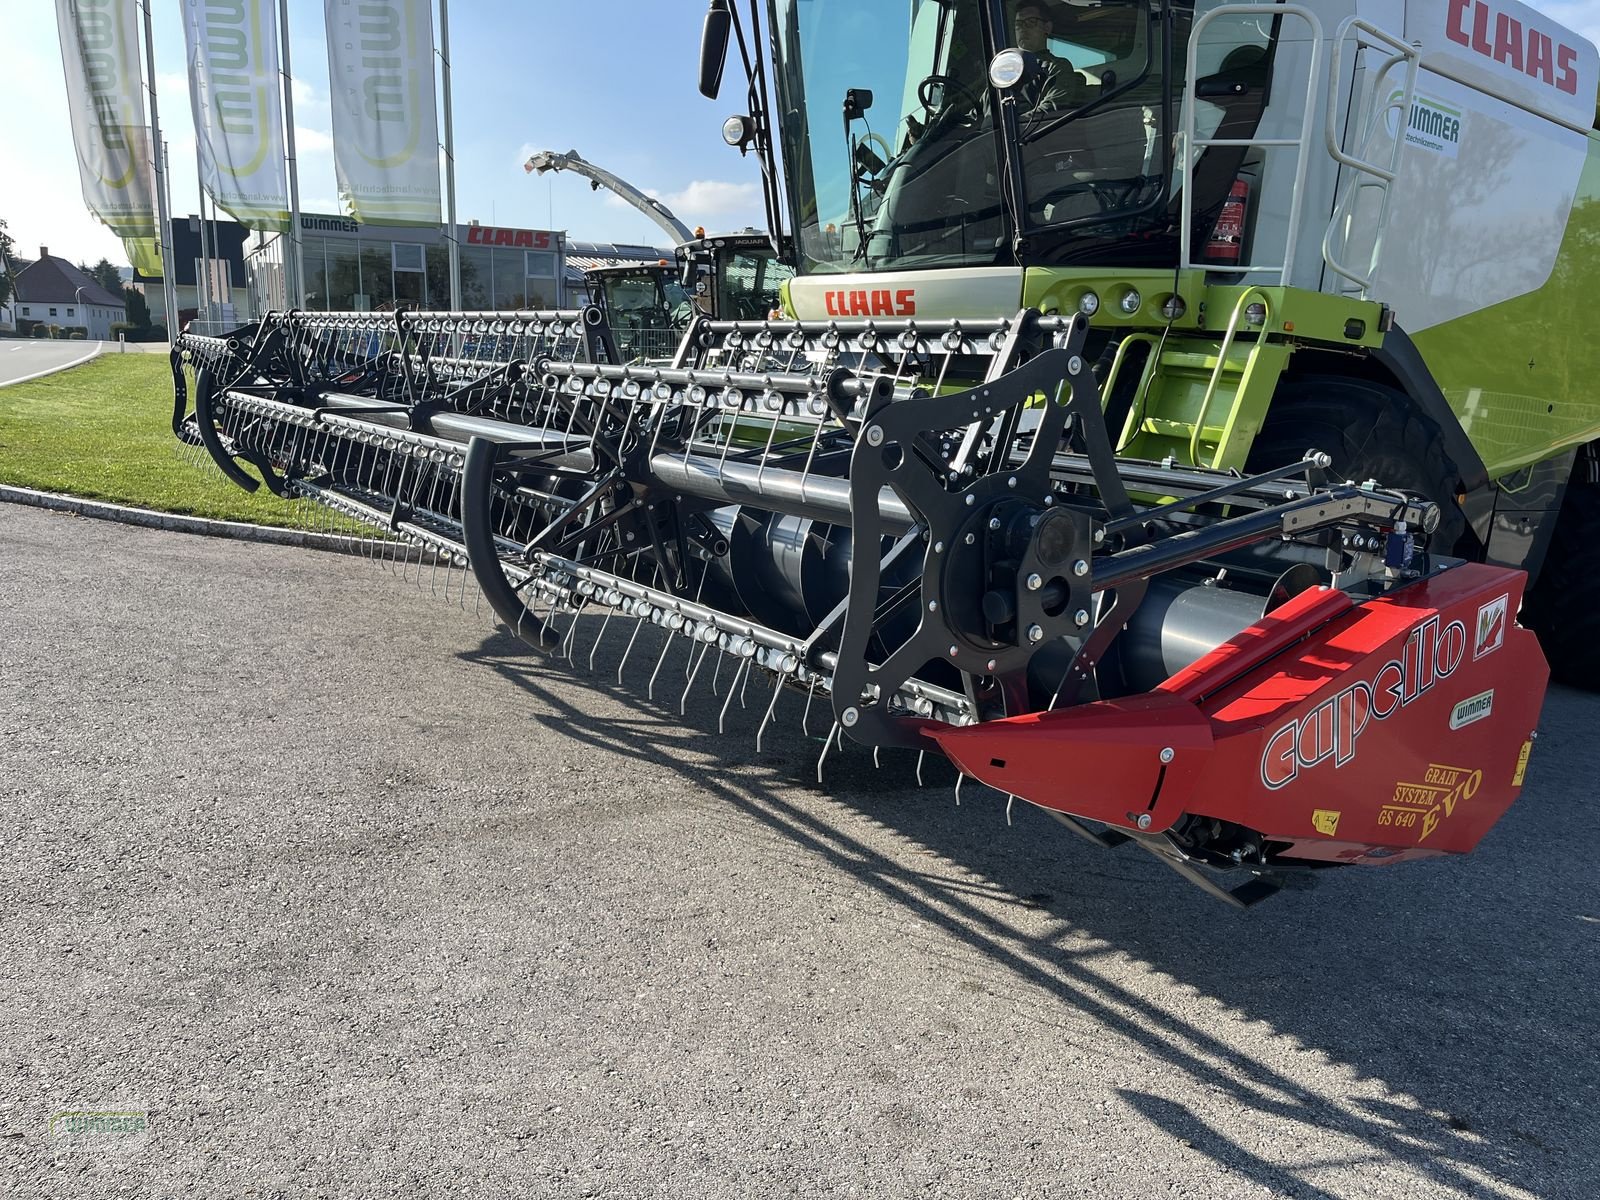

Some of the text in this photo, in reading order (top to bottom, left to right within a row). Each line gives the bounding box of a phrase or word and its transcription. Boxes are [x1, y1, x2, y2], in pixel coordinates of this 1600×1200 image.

[1446, 0, 1578, 96] CLAAS
[301, 217, 359, 233] WIMMER
[467, 227, 551, 249] CLAAS
[825, 289, 916, 316] CLAAS
[1456, 695, 1492, 720] WIMMER
[1424, 768, 1459, 786] GRAIN
[1392, 786, 1437, 806] SYSTEM
[1418, 769, 1482, 843] EVO
[1377, 810, 1416, 828] GS 640
